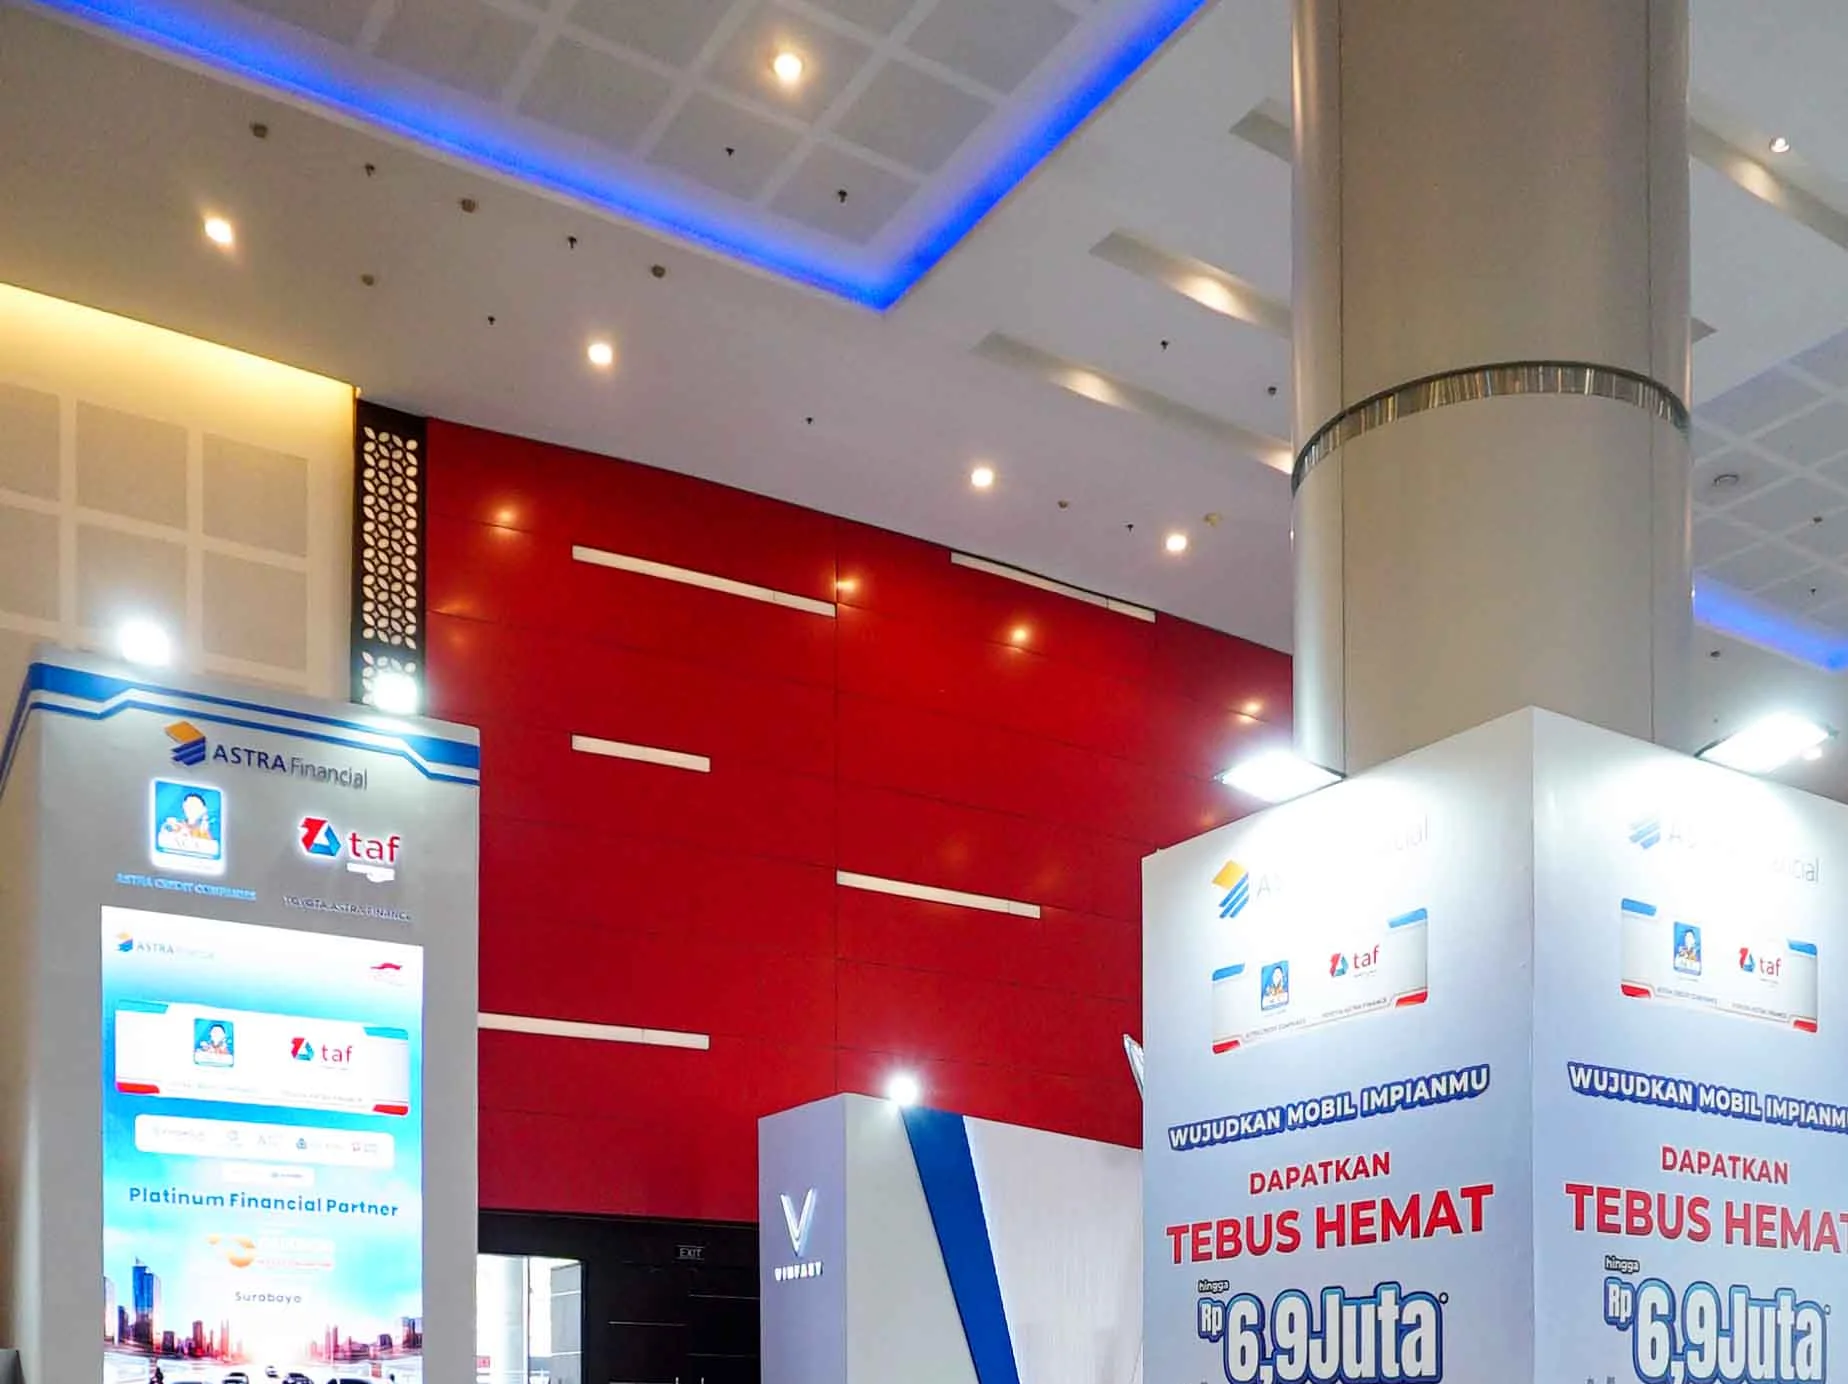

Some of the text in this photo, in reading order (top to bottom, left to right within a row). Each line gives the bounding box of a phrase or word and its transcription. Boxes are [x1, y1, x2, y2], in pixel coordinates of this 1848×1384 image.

[213, 744, 368, 790] ASTRA Financial
[348, 831, 400, 863] taf
[136, 941, 174, 954] ASTRA
[1353, 944, 1380, 969] taf
[1760, 958, 1781, 976] taf
[322, 1045, 353, 1064] taf
[1169, 1065, 1489, 1149] WUJUDKAN MOBIL IMPIANMU
[1569, 1064, 1848, 1131] WUJUDKAN MOBIL IMPIANM
[1250, 1152, 1391, 1195] DAPATKAN
[1661, 1145, 1788, 1184] DAPATKAN
[129, 1187, 398, 1217] Platinum Financial Partner
[1565, 1183, 1711, 1243] TEBUS
[1166, 1183, 1494, 1265] TEBUS HEMAT
[679, 1247, 702, 1258] EXIT
[1605, 1256, 1640, 1273] hingga
[234, 1291, 302, 1306] Surabaya
[1198, 1279, 1229, 1294] hingga
[1199, 1300, 1225, 1339] Rp
[1605, 1279, 1633, 1330] Rp
